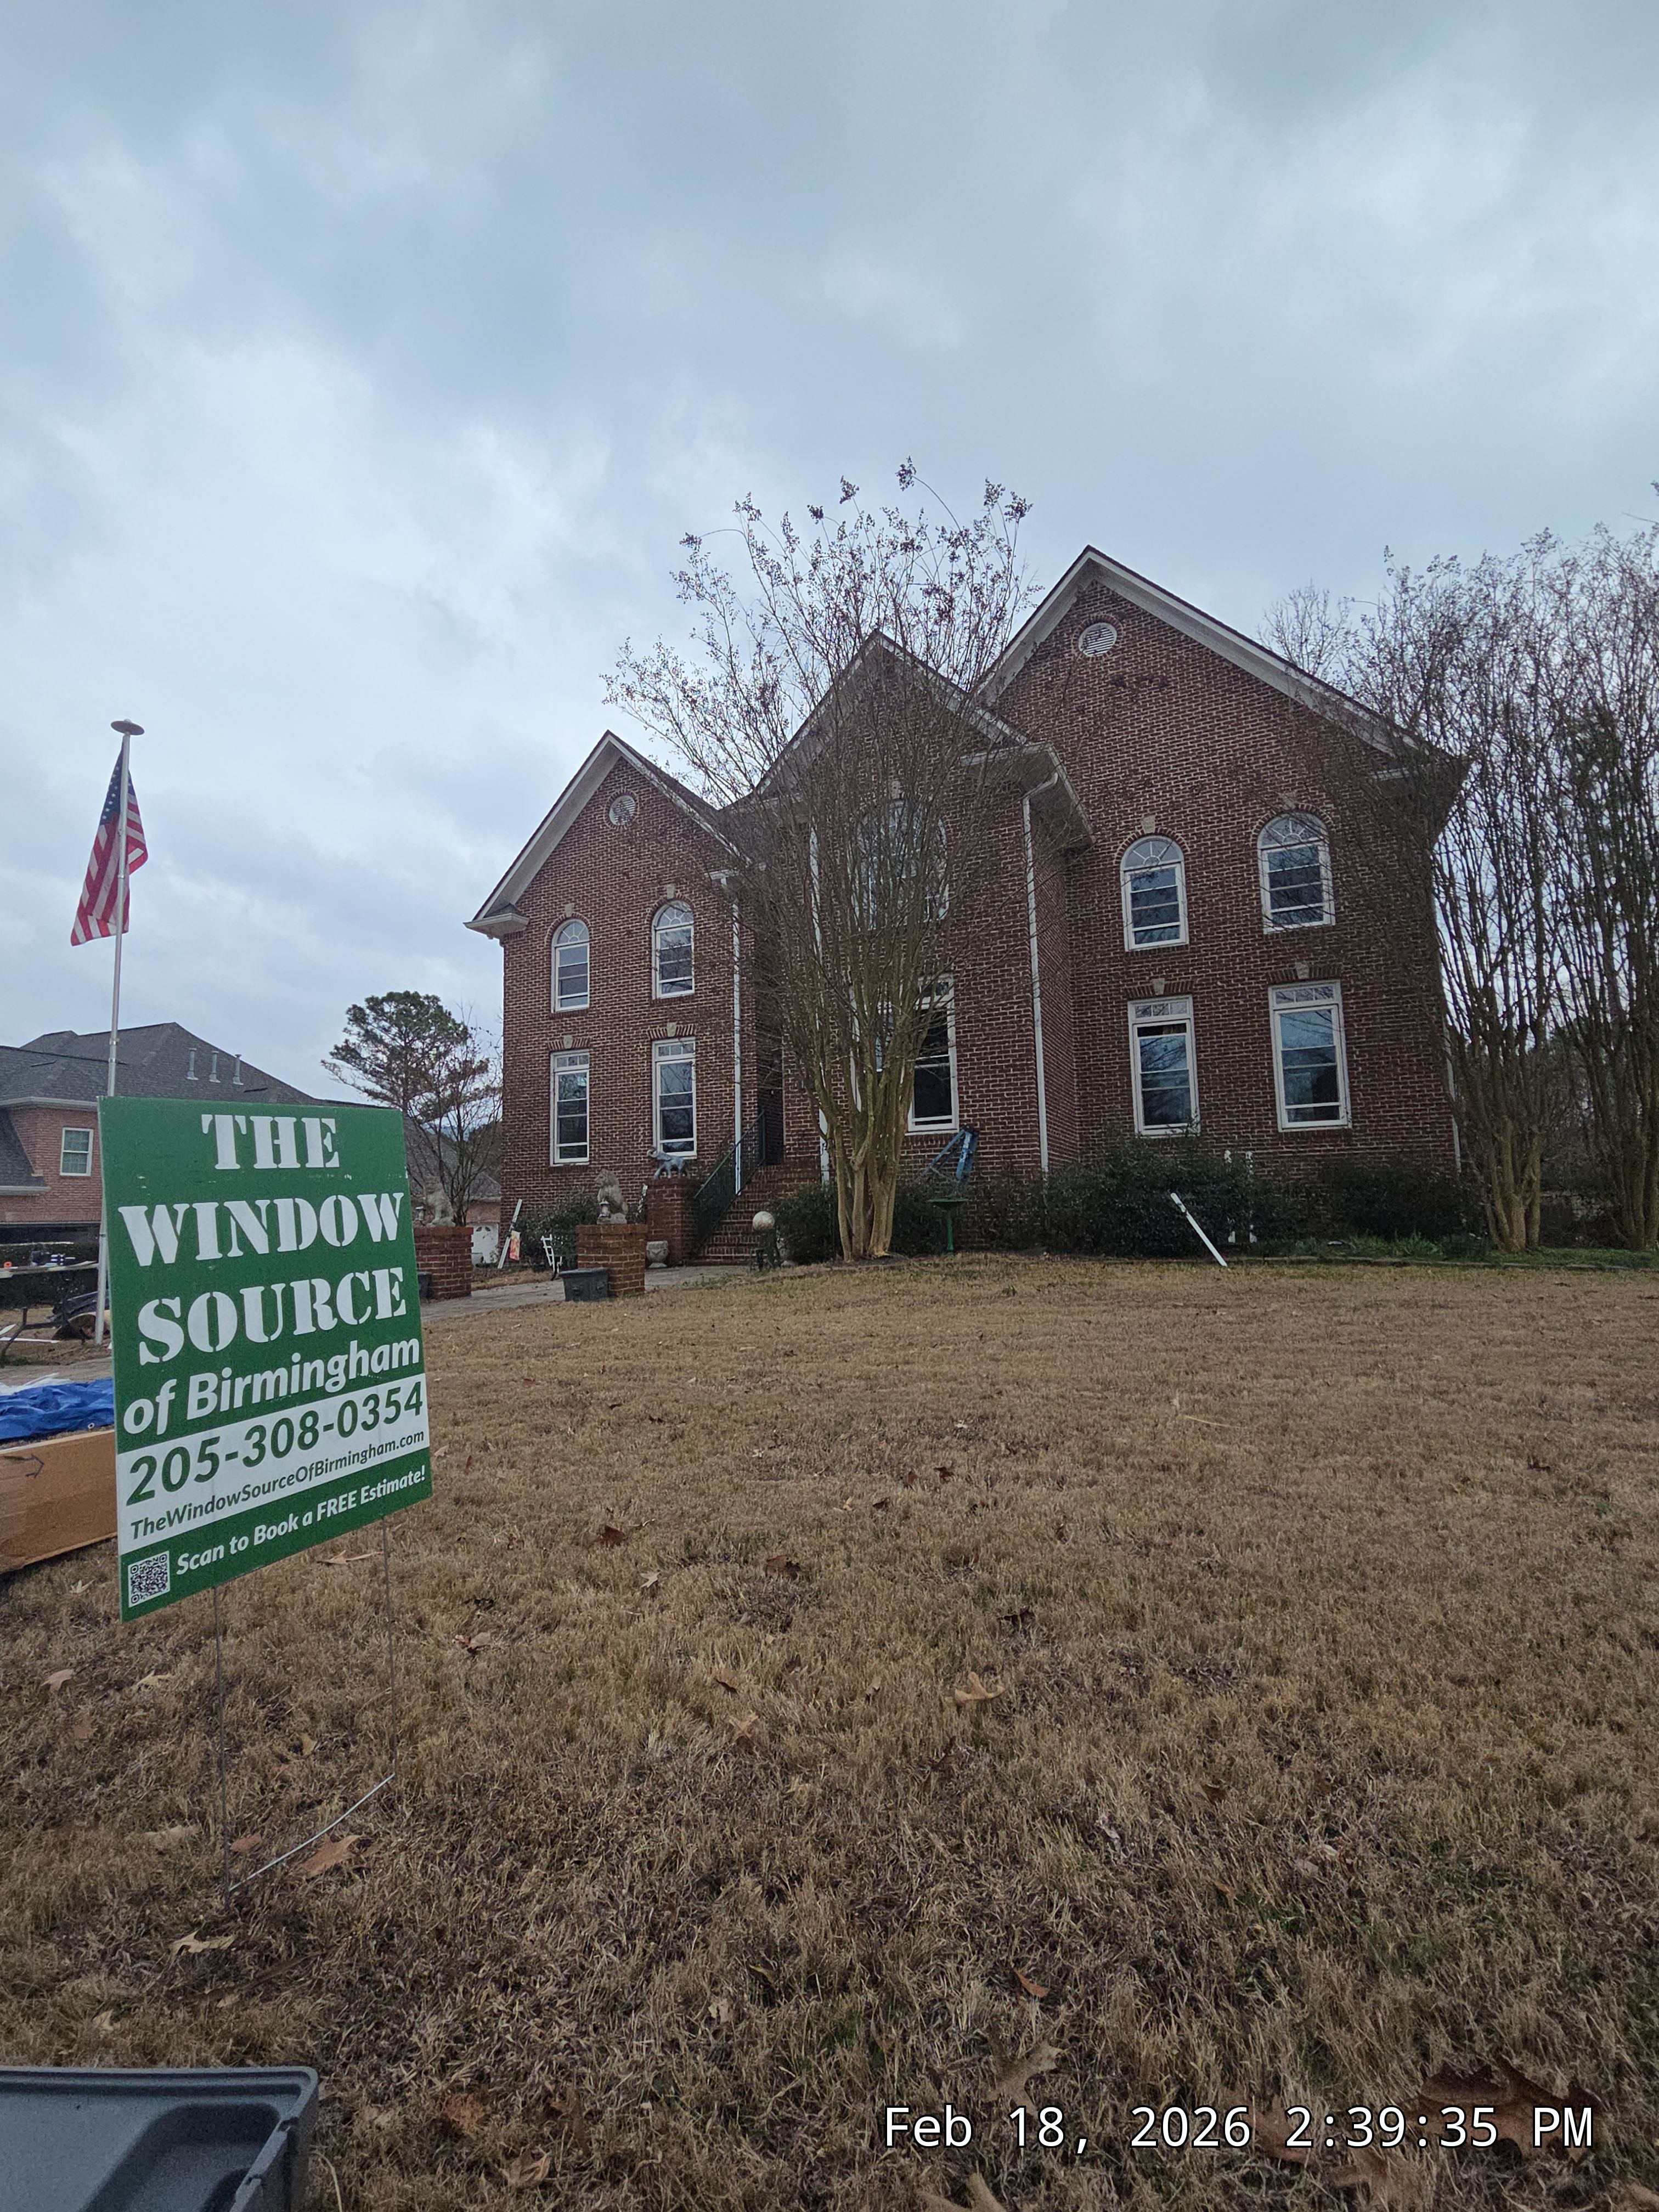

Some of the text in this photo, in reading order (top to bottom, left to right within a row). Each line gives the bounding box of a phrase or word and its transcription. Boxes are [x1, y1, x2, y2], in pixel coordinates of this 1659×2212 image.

[201, 1114, 340, 1170] THE
[118, 1192, 404, 1267] WINDOW
[138, 1267, 407, 1365] SOURCE
[123, 1338, 421, 1435] of Birmingham
[126, 1380, 424, 1506] 205-308-0354
[130, 1429, 425, 1541] TheWindowSourceOfBirmingham.com
[176, 1464, 426, 1575] Scan to Book a FREE Estimate!
